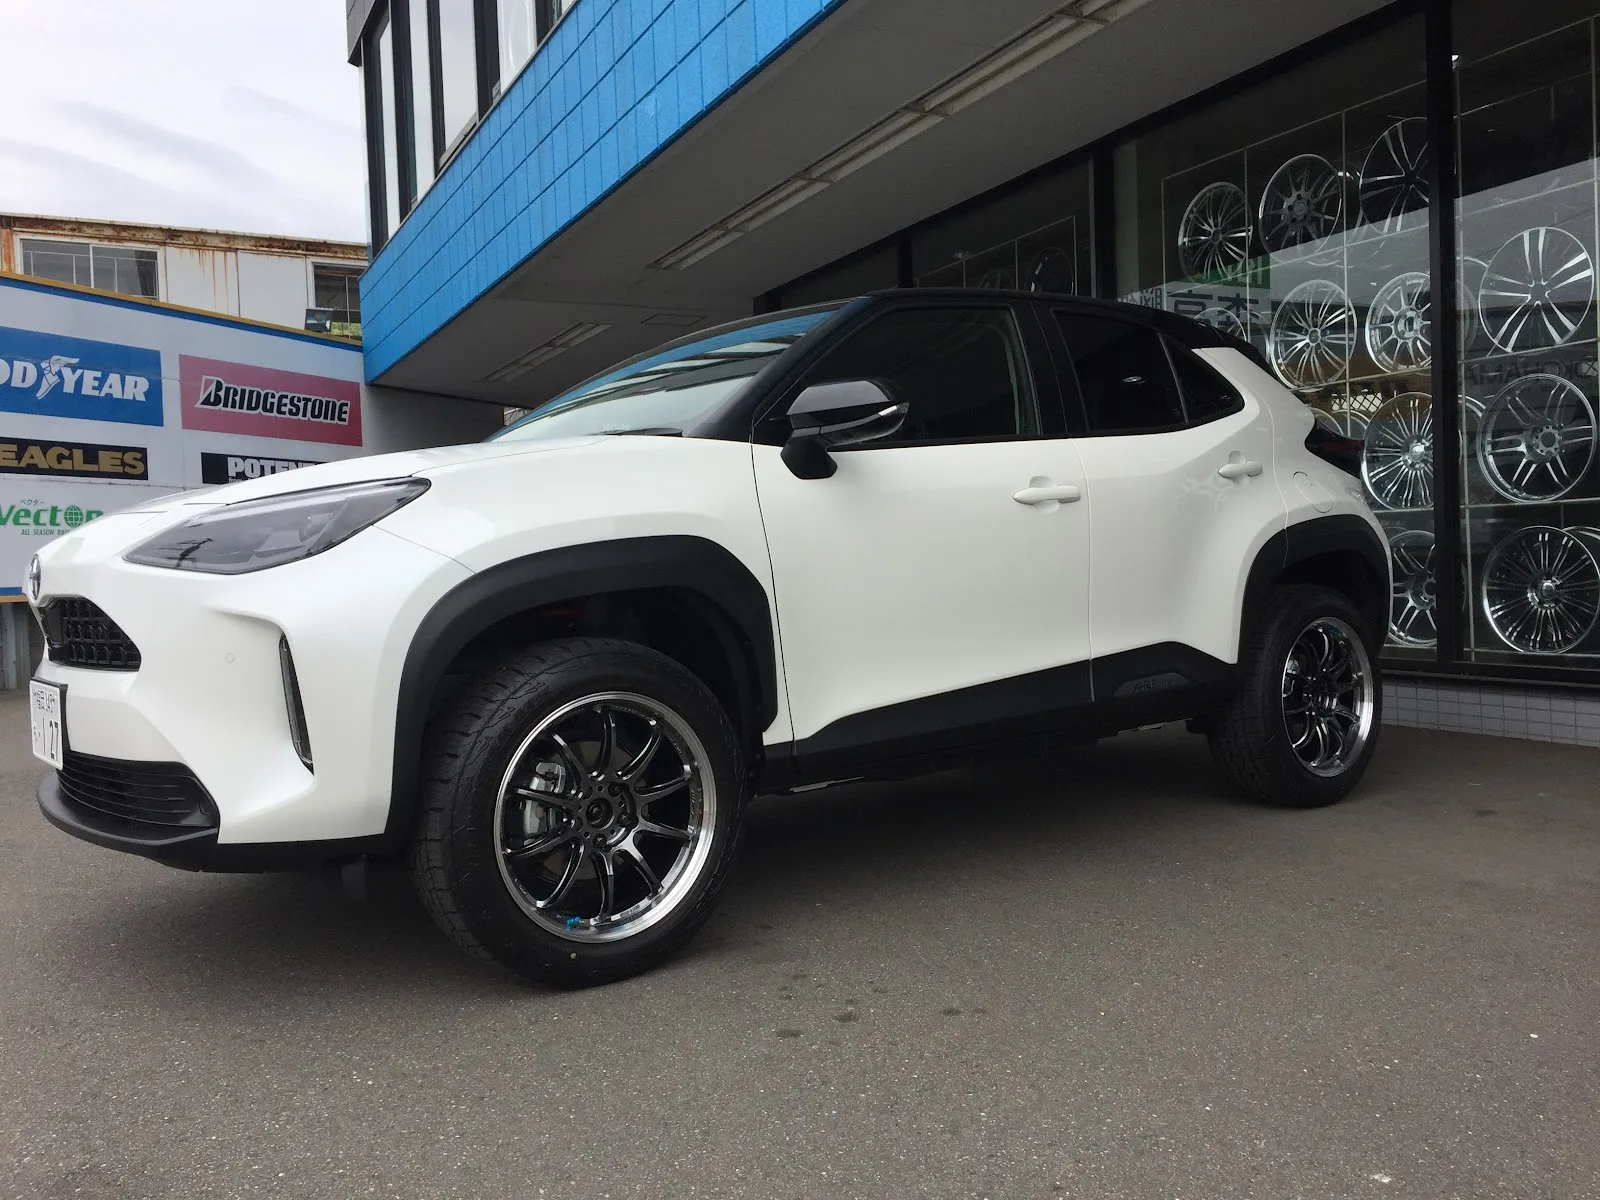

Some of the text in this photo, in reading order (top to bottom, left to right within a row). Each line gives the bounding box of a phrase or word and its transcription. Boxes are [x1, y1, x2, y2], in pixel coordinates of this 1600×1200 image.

[199, 379, 350, 423] BRIDGESTONE
[0, 443, 145, 475] EAGLES
[20, 528, 30, 536] ALL
[33, 528, 55, 536] SEASON
